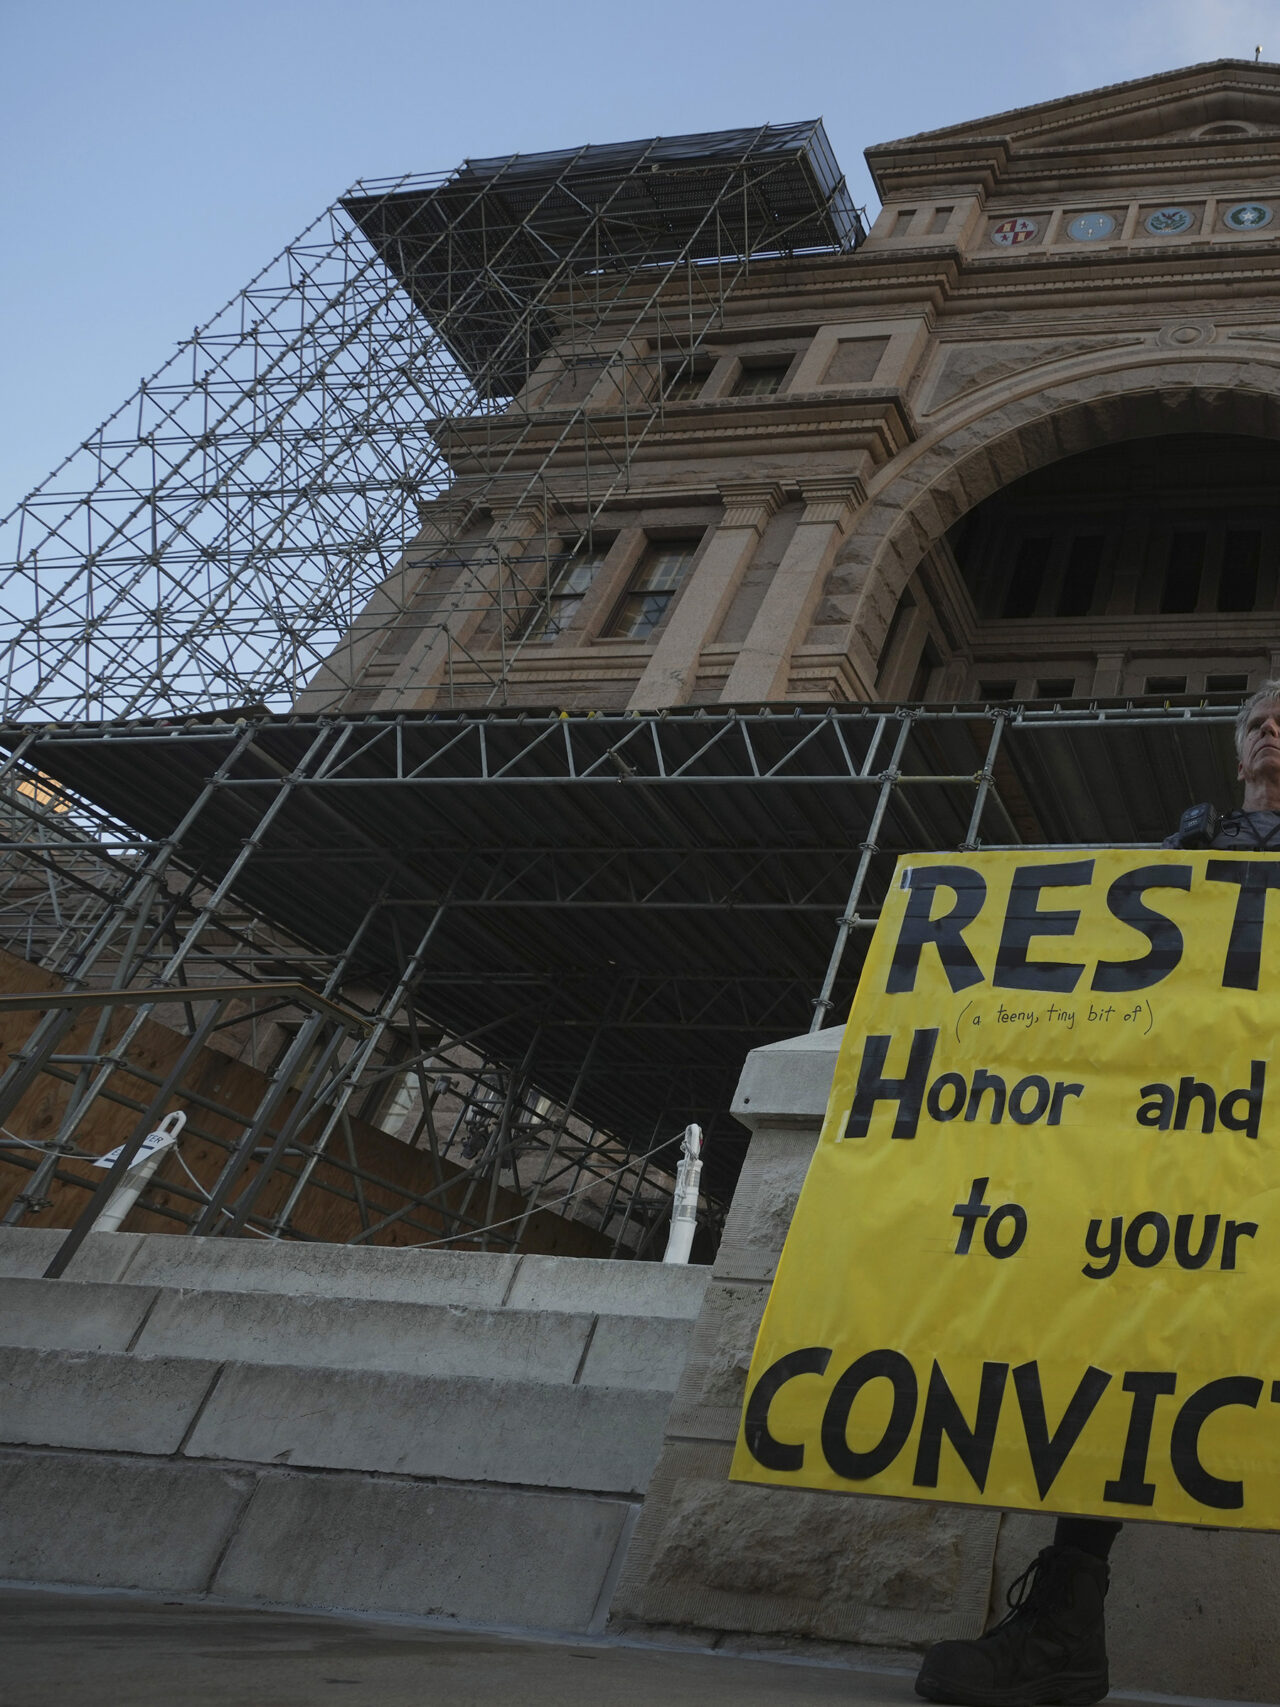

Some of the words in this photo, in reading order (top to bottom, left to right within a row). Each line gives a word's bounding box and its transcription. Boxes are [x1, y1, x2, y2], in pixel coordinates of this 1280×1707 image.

[997, 1004, 1040, 1029] teeny,
[1047, 1003, 1075, 1030] tiny
[1087, 1004, 1116, 1022] bit
[1123, 1000, 1153, 1035] of)
[844, 1029, 1084, 1139] Honor
[1137, 1061, 1265, 1139] and
[953, 1177, 1027, 1259] to
[1082, 1212, 1258, 1279] your
